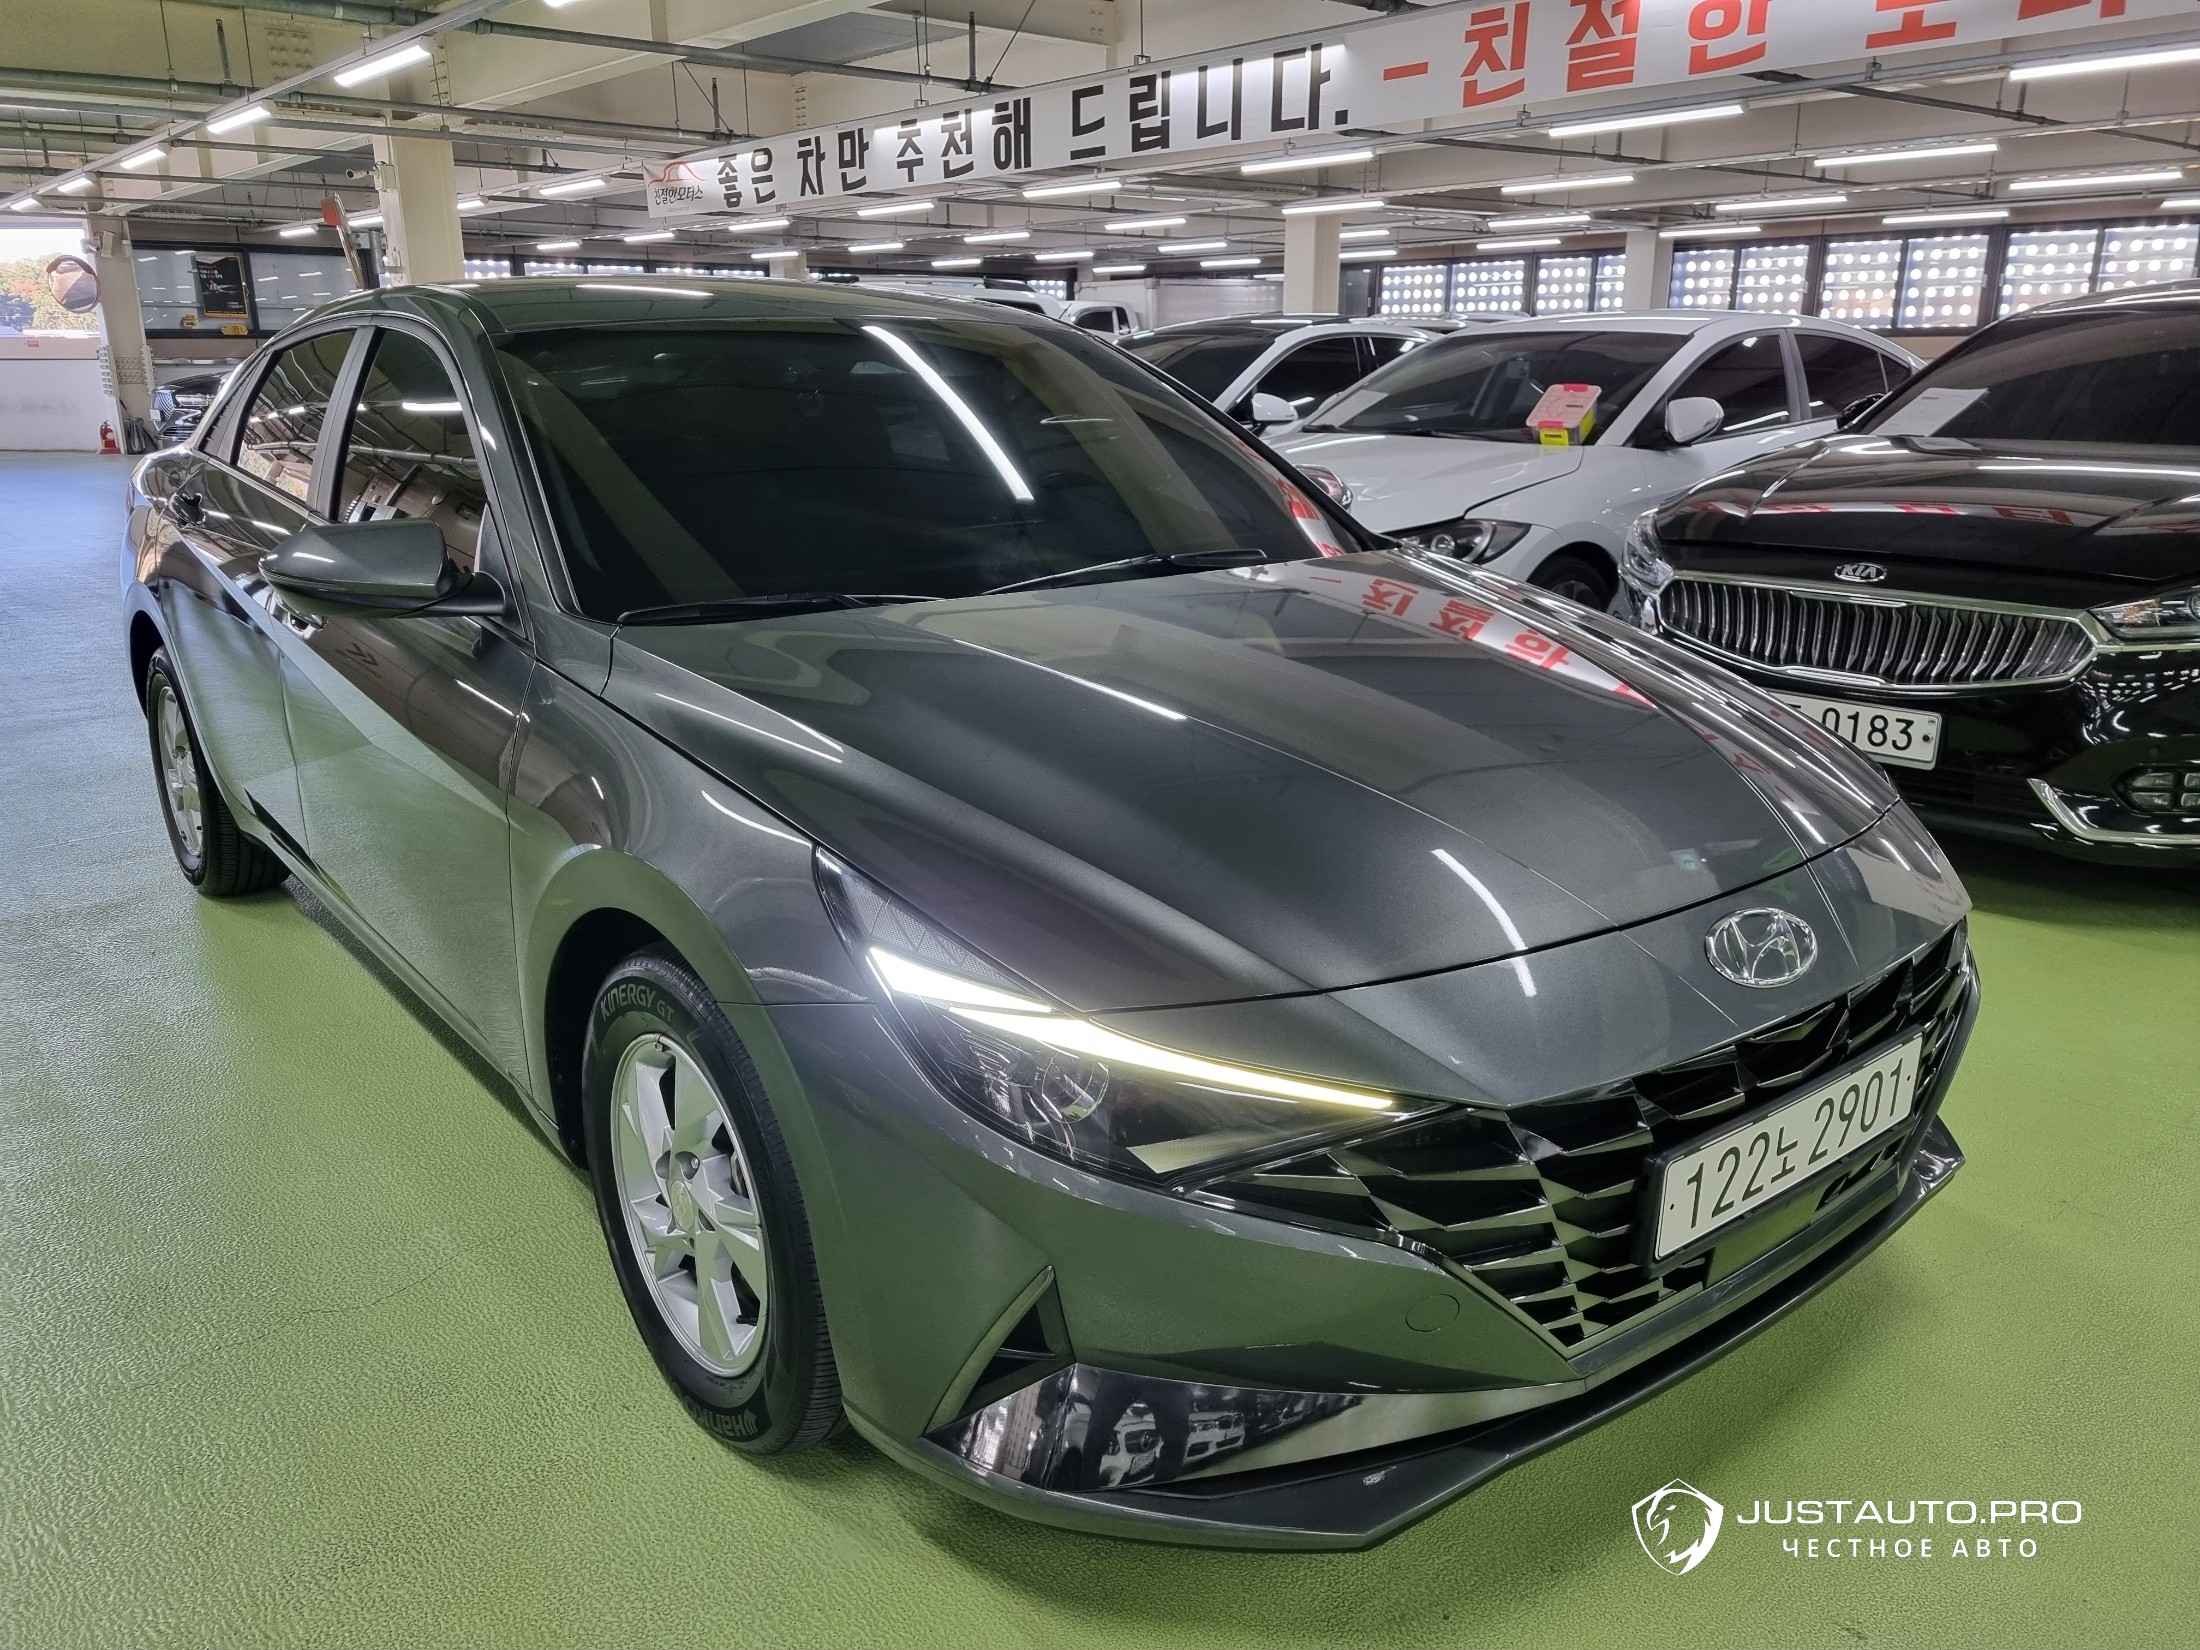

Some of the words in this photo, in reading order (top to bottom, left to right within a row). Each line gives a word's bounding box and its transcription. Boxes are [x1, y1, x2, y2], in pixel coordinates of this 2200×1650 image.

[717, 147, 776, 208] 좋은
[797, 137, 869, 196] 차만
[895, 96, 1032, 170] 추천해
[1070, 43, 1349, 160] 드립니다.
[657, 999, 675, 1022] GT
[1686, 1126, 1799, 1230] 122노
[1807, 1057, 1904, 1167] 2901
